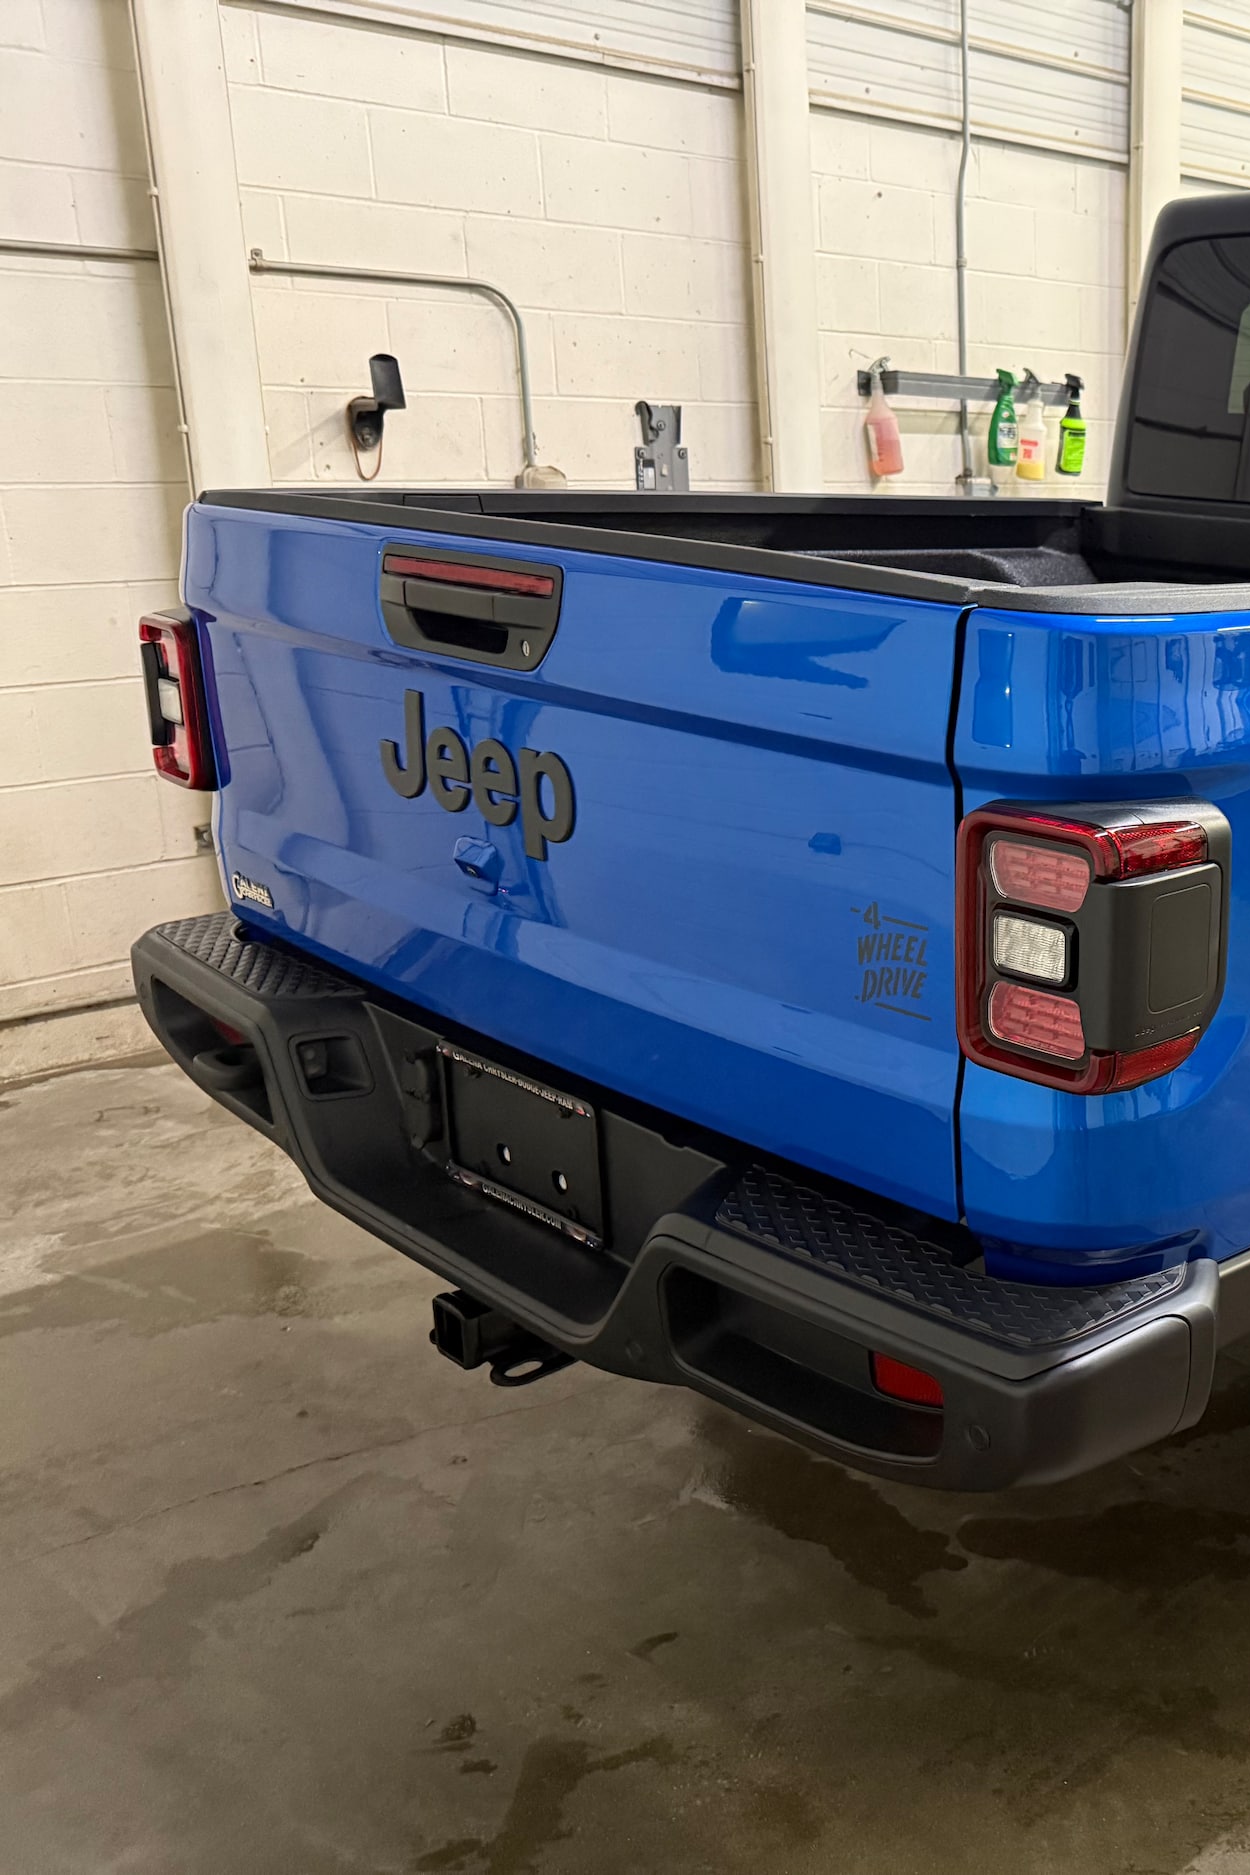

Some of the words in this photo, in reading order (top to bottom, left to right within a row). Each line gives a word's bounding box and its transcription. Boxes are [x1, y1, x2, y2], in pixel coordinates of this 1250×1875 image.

[379, 689, 577, 861] Jeep
[863, 901, 881, 930] 4
[857, 932, 928, 967] WHEEL
[861, 966, 927, 1003] DRIVE
